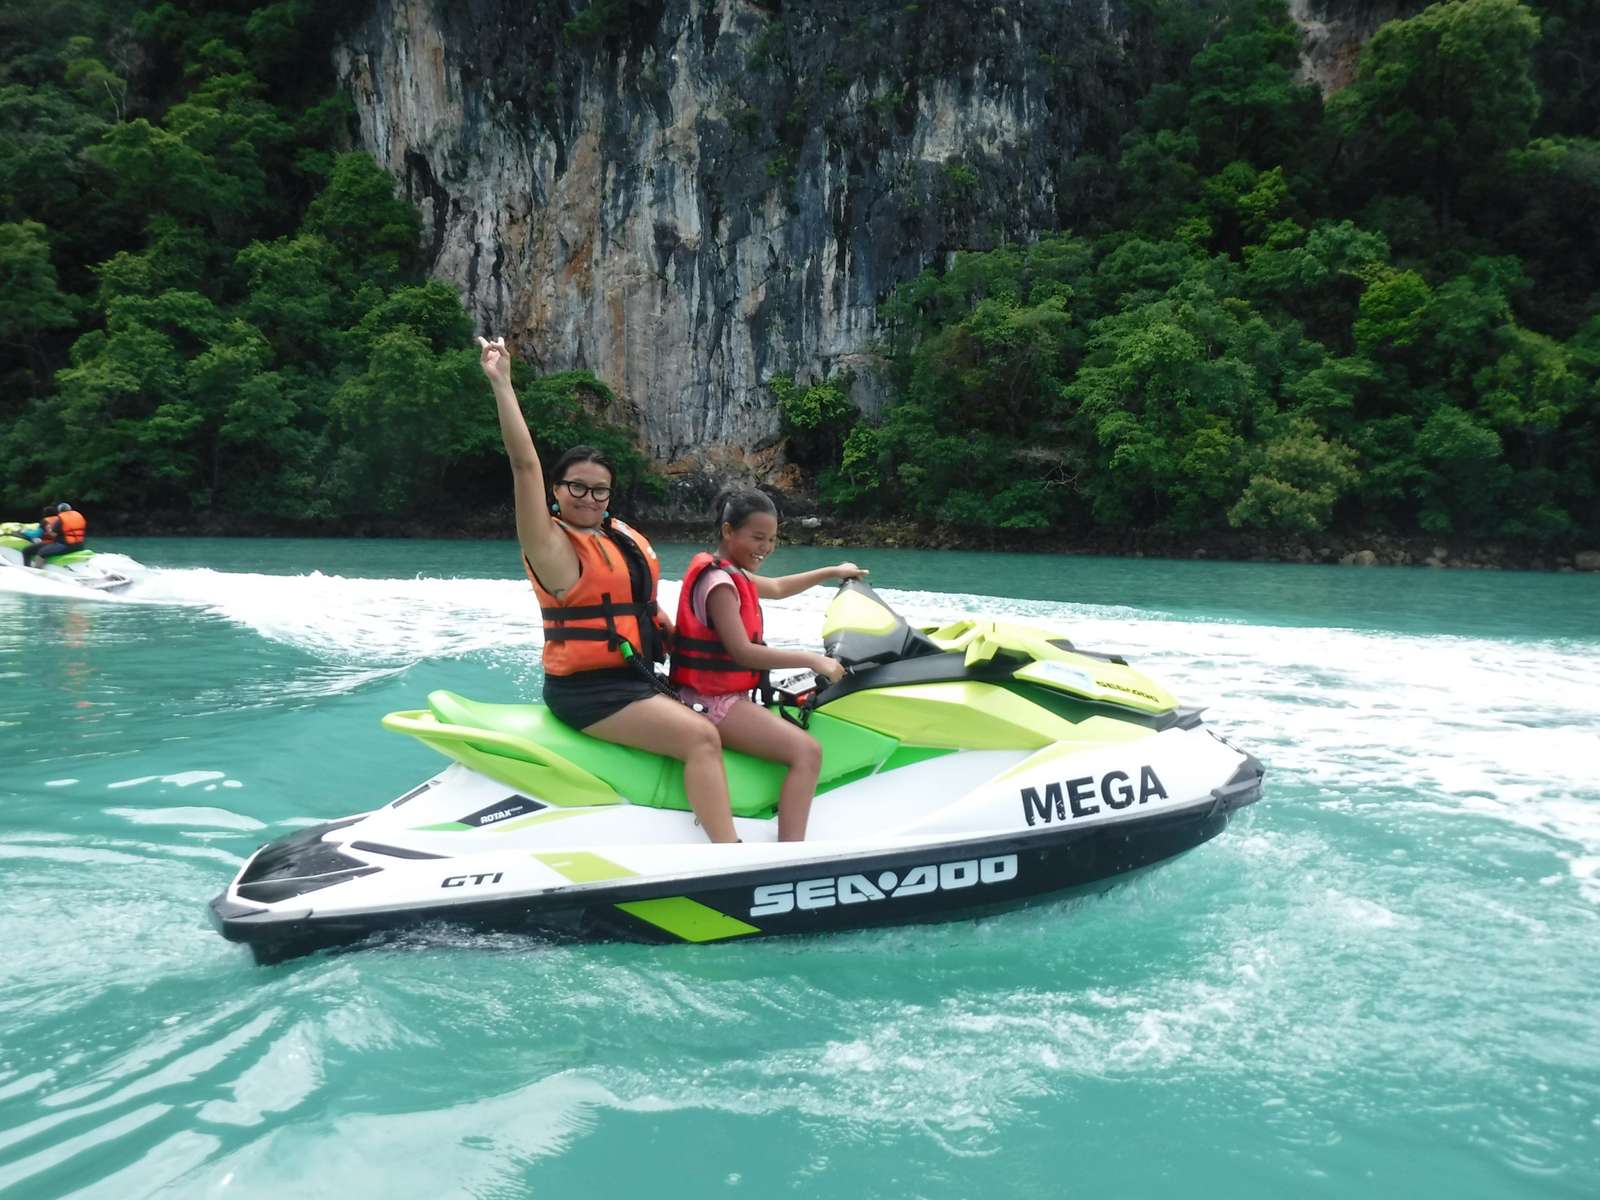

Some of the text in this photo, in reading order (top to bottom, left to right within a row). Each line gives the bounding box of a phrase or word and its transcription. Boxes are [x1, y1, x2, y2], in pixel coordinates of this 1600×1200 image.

[1020, 765, 1169, 826] MEGA
[480, 808, 512, 824] ROTAX
[441, 872, 504, 888] GTI
